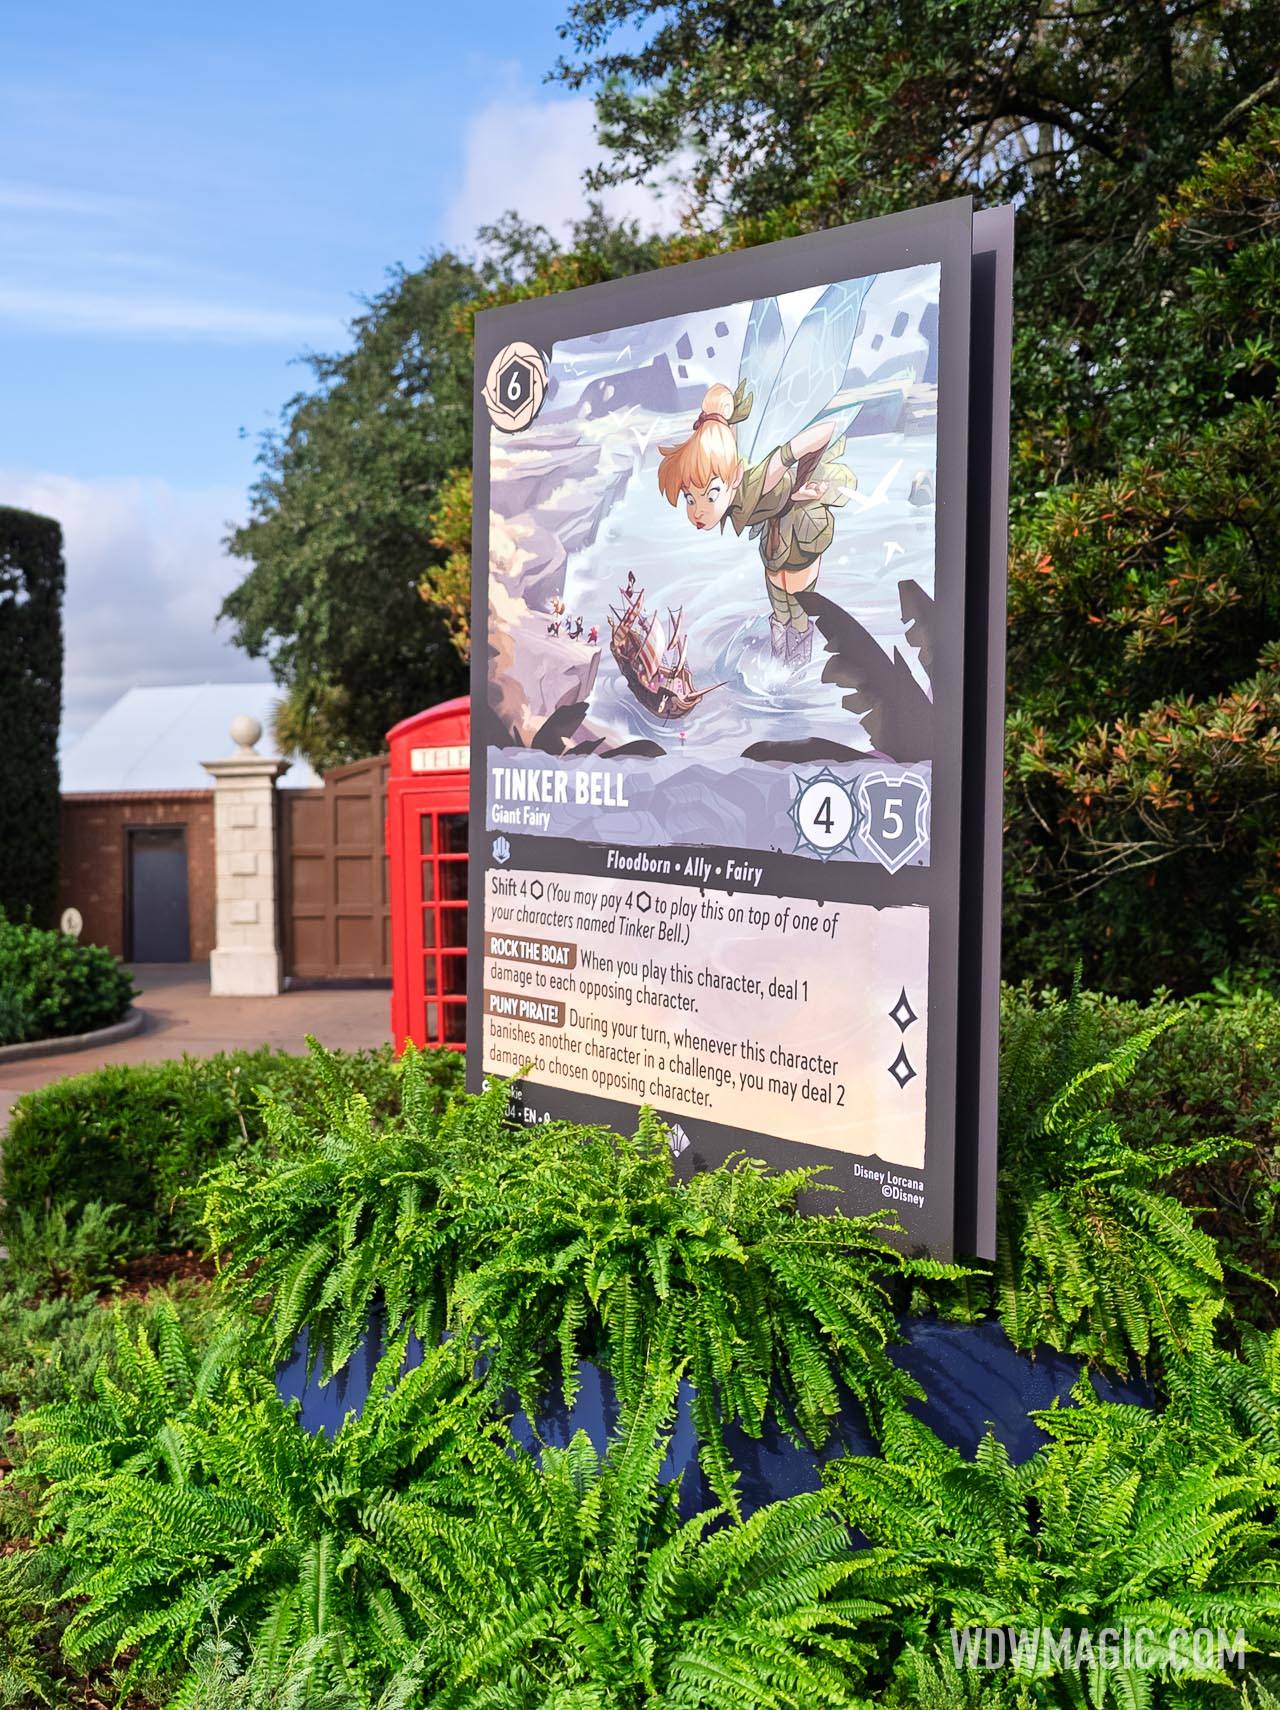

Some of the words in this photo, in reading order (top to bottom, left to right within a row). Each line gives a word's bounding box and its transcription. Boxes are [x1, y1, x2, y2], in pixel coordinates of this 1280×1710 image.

[508, 371, 521, 400] 6
[492, 767, 568, 804] TINKER
[575, 770, 629, 808] BELL
[491, 803, 521, 825] Giant
[523, 806, 551, 832] Fairy
[813, 796, 835, 834] 4
[882, 799, 904, 839] 5
[607, 849, 671, 874] Floodborn
[683, 856, 712, 883] Ally
[725, 859, 763, 888] Fairy
[491, 876, 517, 897] Shift
[520, 879, 527, 895] 4
[546, 882, 571, 903] (You
[574, 889, 598, 910] may
[601, 893, 622, 913] pay
[625, 891, 633, 909] 4
[655, 897, 667, 914] to
[670, 896, 698, 922] play
[701, 899, 724, 921] this
[728, 907, 744, 923] on
[748, 906, 770, 931] top
[774, 907, 791, 933] of
[792, 913, 819, 932] one
[822, 912, 840, 939] of
[491, 905, 515, 922] your
[516, 905, 574, 929] characters
[576, 915, 615, 934] named
[619, 915, 656, 940] Tinker
[658, 920, 691, 946] Bell.)
[490, 936, 519, 958] ROCK
[519, 942, 540, 961] THE
[541, 945, 570, 965] BOAT
[580, 948, 614, 973] When
[616, 960, 638, 978] you
[642, 958, 667, 985] play
[670, 962, 694, 985] this
[697, 967, 765, 1000] character,
[768, 976, 798, 1001] deal
[802, 980, 808, 1002] 1
[490, 961, 533, 988] damage
[535, 970, 547, 987] to
[549, 972, 576, 993] each
[579, 980, 632, 1007] opposing
[636, 984, 699, 1013] character.
[489, 994, 519, 1016] PUNY
[520, 1001, 559, 1024] PIRATE!
[570, 1008, 608, 1038] During
[611, 1022, 638, 1039] your
[640, 1023, 671, 1049] turn,
[673, 1028, 738, 1057] whenever
[740, 1039, 766, 1063] this
[769, 1044, 839, 1076] character
[490, 1018, 536, 1045] banishes
[538, 1032, 582, 1054] another
[585, 1037, 641, 1065] character
[644, 1048, 655, 1068] in
[658, 1056, 665, 1071] a
[669, 1053, 736, 1089] challenge,
[739, 1071, 764, 1092] you
[768, 1077, 798, 1102] may
[801, 1078, 832, 1104] deal
[836, 1084, 846, 1107] 2
[535, 1054, 546, 1071] to
[548, 1055, 588, 1081] chosen
[592, 1071, 646, 1098] opposing
[649, 1076, 713, 1108] character.
[523, 1107, 537, 1124] EN
[853, 1163, 885, 1185] Disney
[887, 1171, 924, 1192] Lorcana
[881, 1184, 925, 1209] ©Disney
